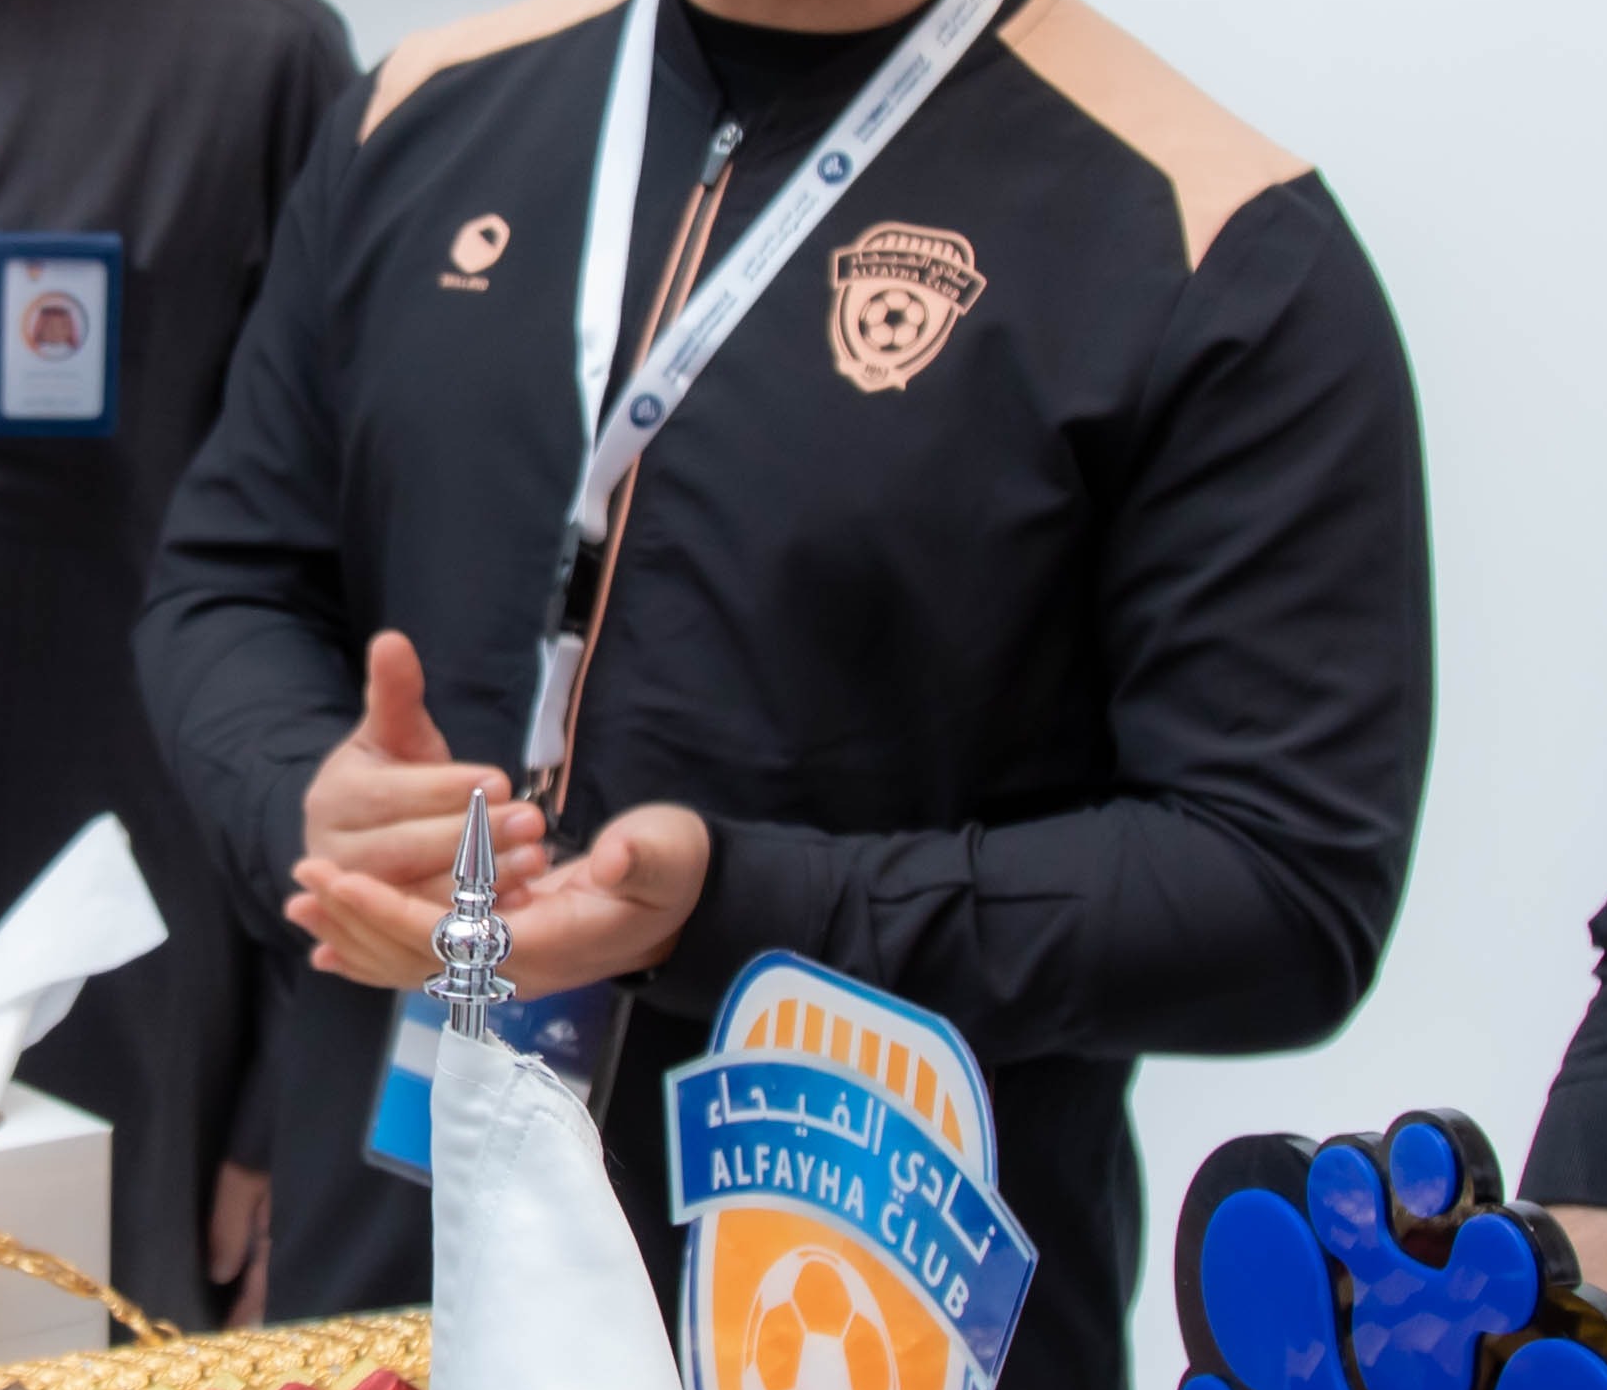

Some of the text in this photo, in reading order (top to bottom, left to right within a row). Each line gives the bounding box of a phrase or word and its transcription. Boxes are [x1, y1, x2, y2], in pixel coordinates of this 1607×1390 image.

[707, 1070, 997, 1266] نادي الفيحاء
[712, 1143, 970, 1319] ALFAYHA CLUB
